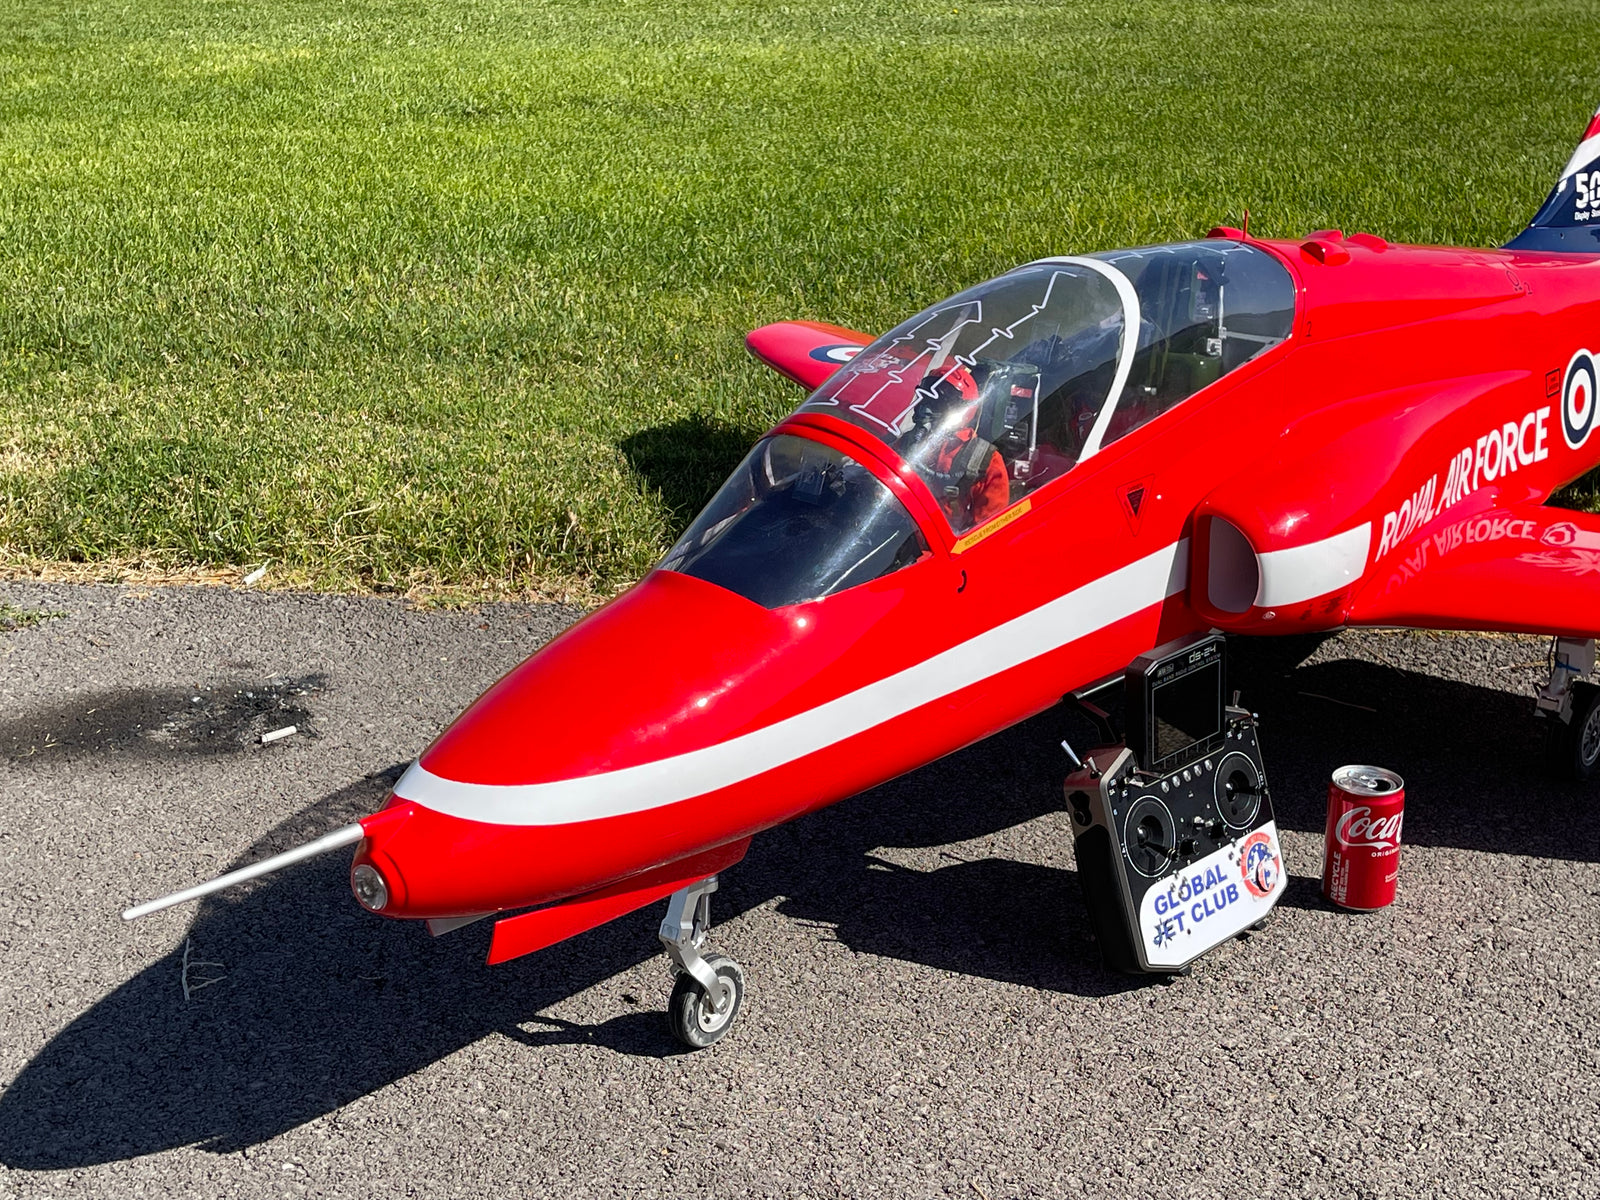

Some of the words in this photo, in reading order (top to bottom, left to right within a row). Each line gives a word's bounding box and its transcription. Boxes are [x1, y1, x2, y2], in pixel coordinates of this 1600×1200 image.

[1375, 474, 1437, 563] ROYAL
[1435, 447, 1473, 515] AIR
[1472, 405, 1551, 491] FORCE
[1154, 864, 1228, 915] GLOBAL
[1330, 851, 1341, 901] RECYCLE
[1338, 885, 1347, 903] ME
[1153, 910, 1185, 946] JET
[1191, 883, 1239, 923] CLUB
